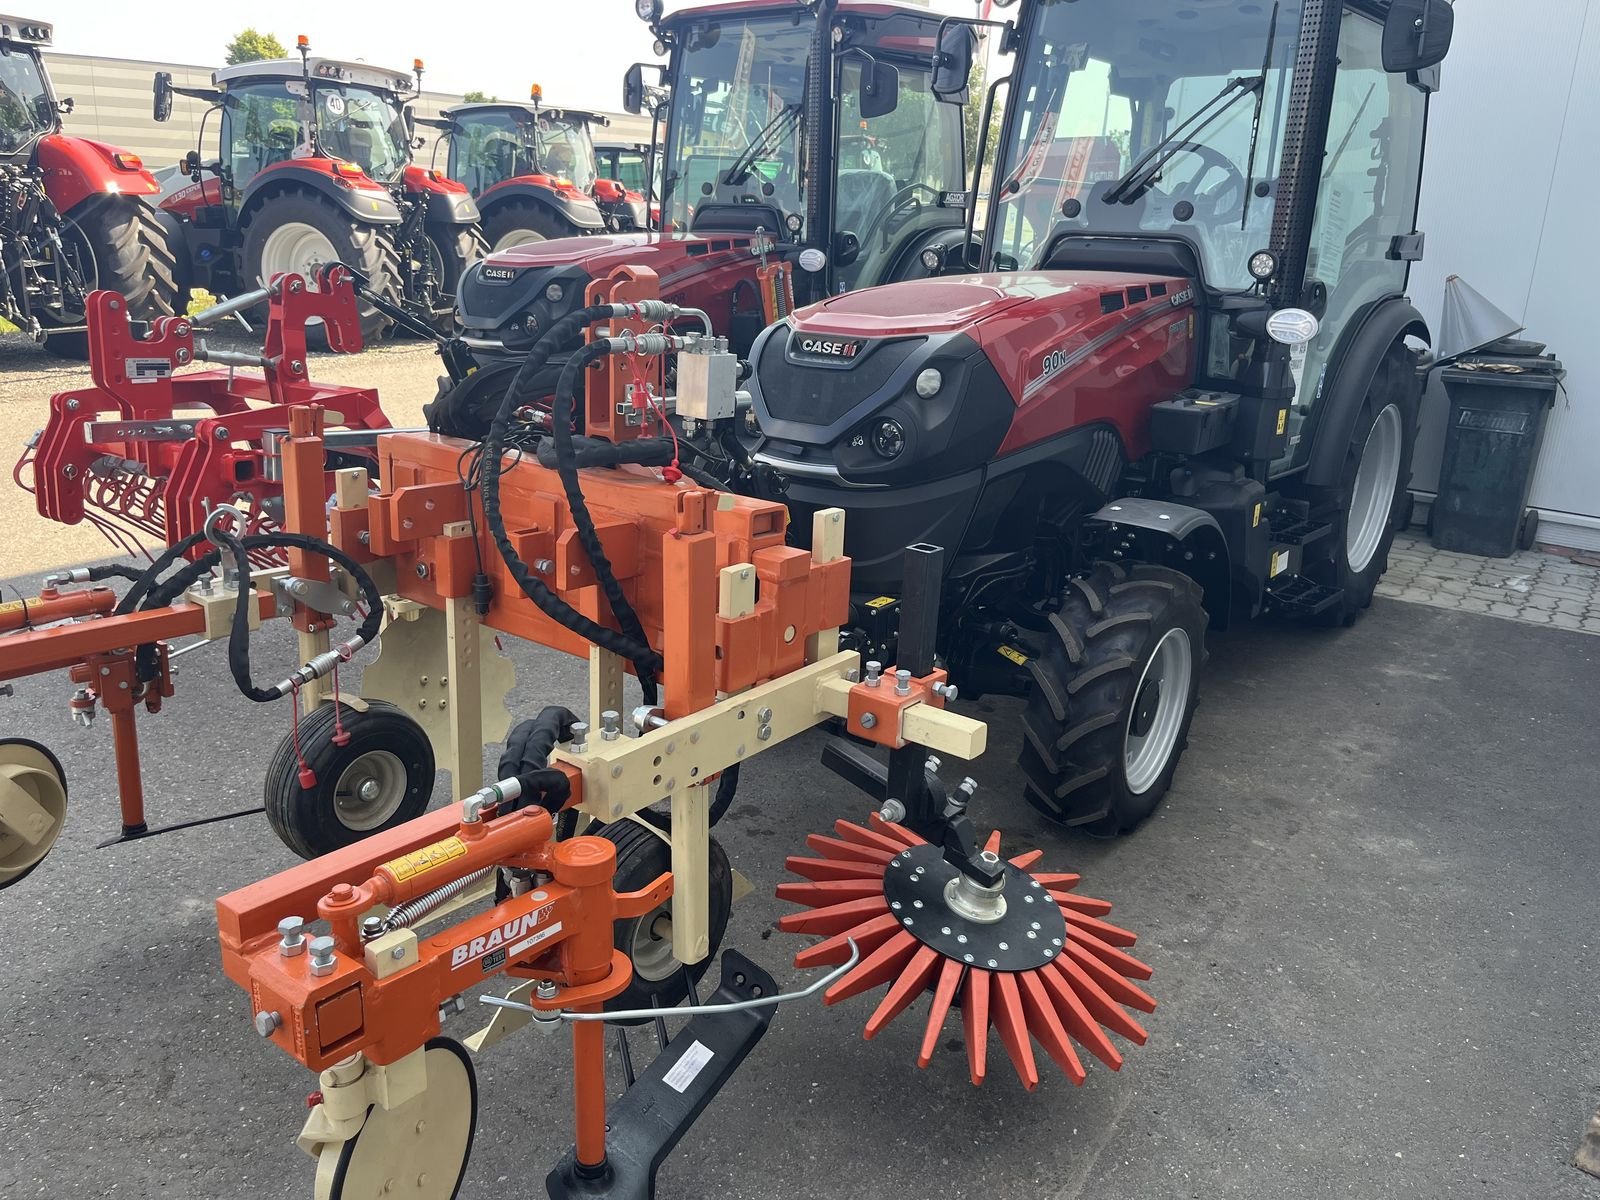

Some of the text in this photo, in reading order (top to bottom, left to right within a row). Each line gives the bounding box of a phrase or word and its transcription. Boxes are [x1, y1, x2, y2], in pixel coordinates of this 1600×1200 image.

[330, 98, 341, 110] 40
[486, 269, 507, 279] CASE
[802, 339, 843, 355] CASE
[451, 909, 540, 967] BRAUN
